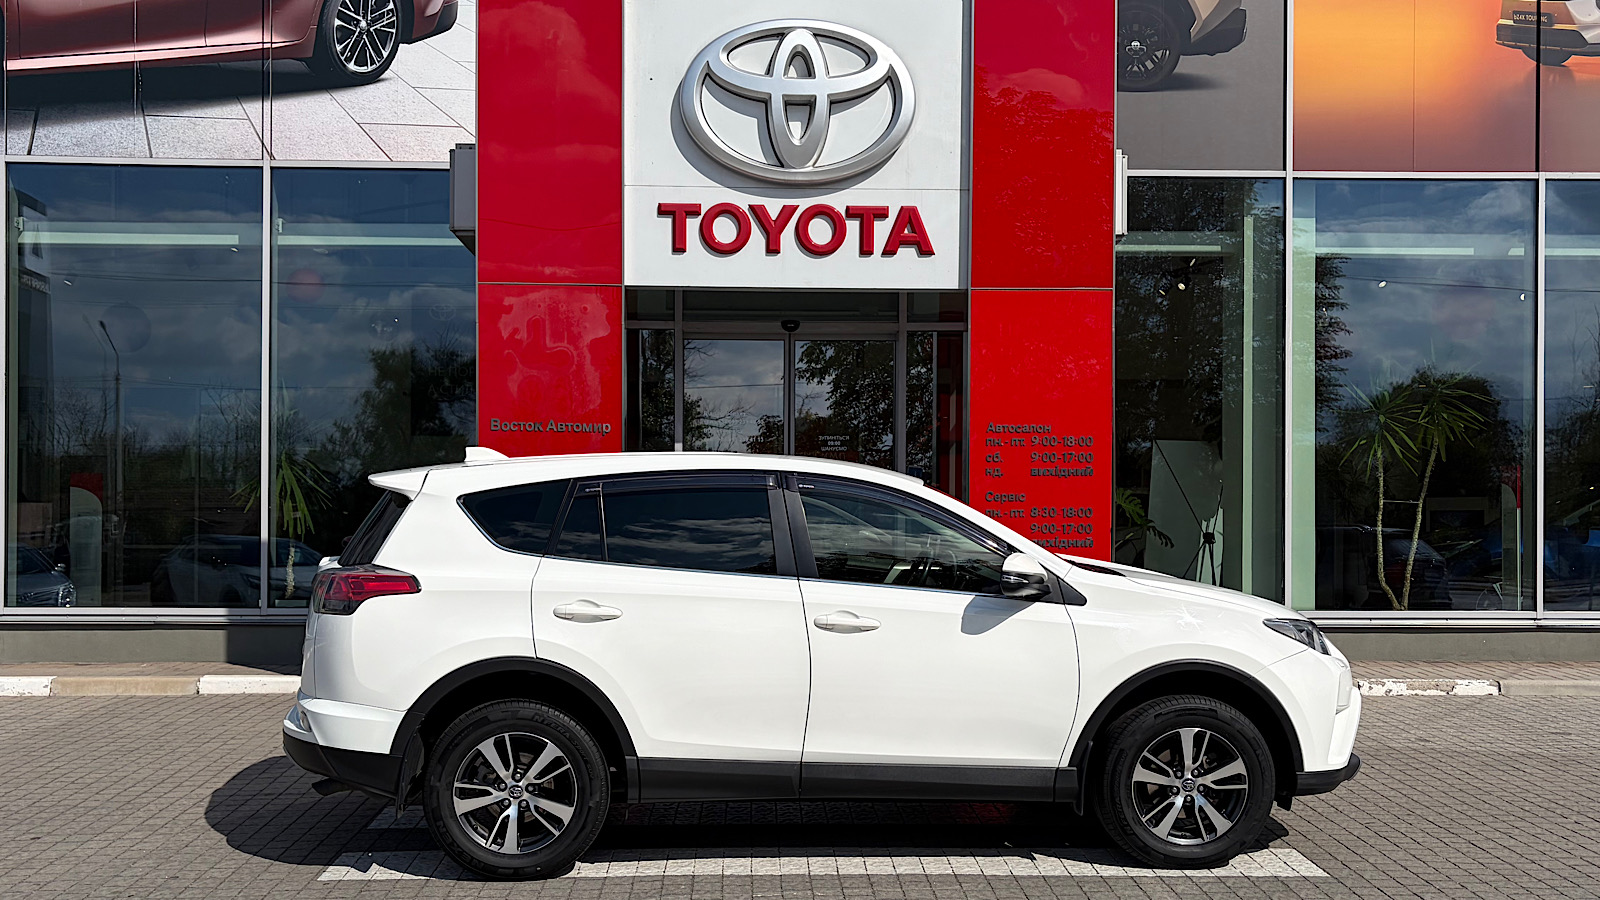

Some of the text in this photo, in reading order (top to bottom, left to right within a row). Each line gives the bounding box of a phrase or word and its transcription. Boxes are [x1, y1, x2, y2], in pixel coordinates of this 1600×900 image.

[657, 202, 936, 257] TOYOTA
[490, 418, 612, 436] Восток Автомир
[986, 422, 1052, 433] Автосалон
[1030, 435, 1094, 447] 9:00-18:00
[985, 451, 1094, 463] сб. 9:00-17:00
[985, 465, 1094, 478] нд. вихідний
[985, 491, 1026, 504] Сервіс
[1030, 506, 1093, 518] 8:30-18:00
[1030, 523, 1093, 534] 9:00-17:00
